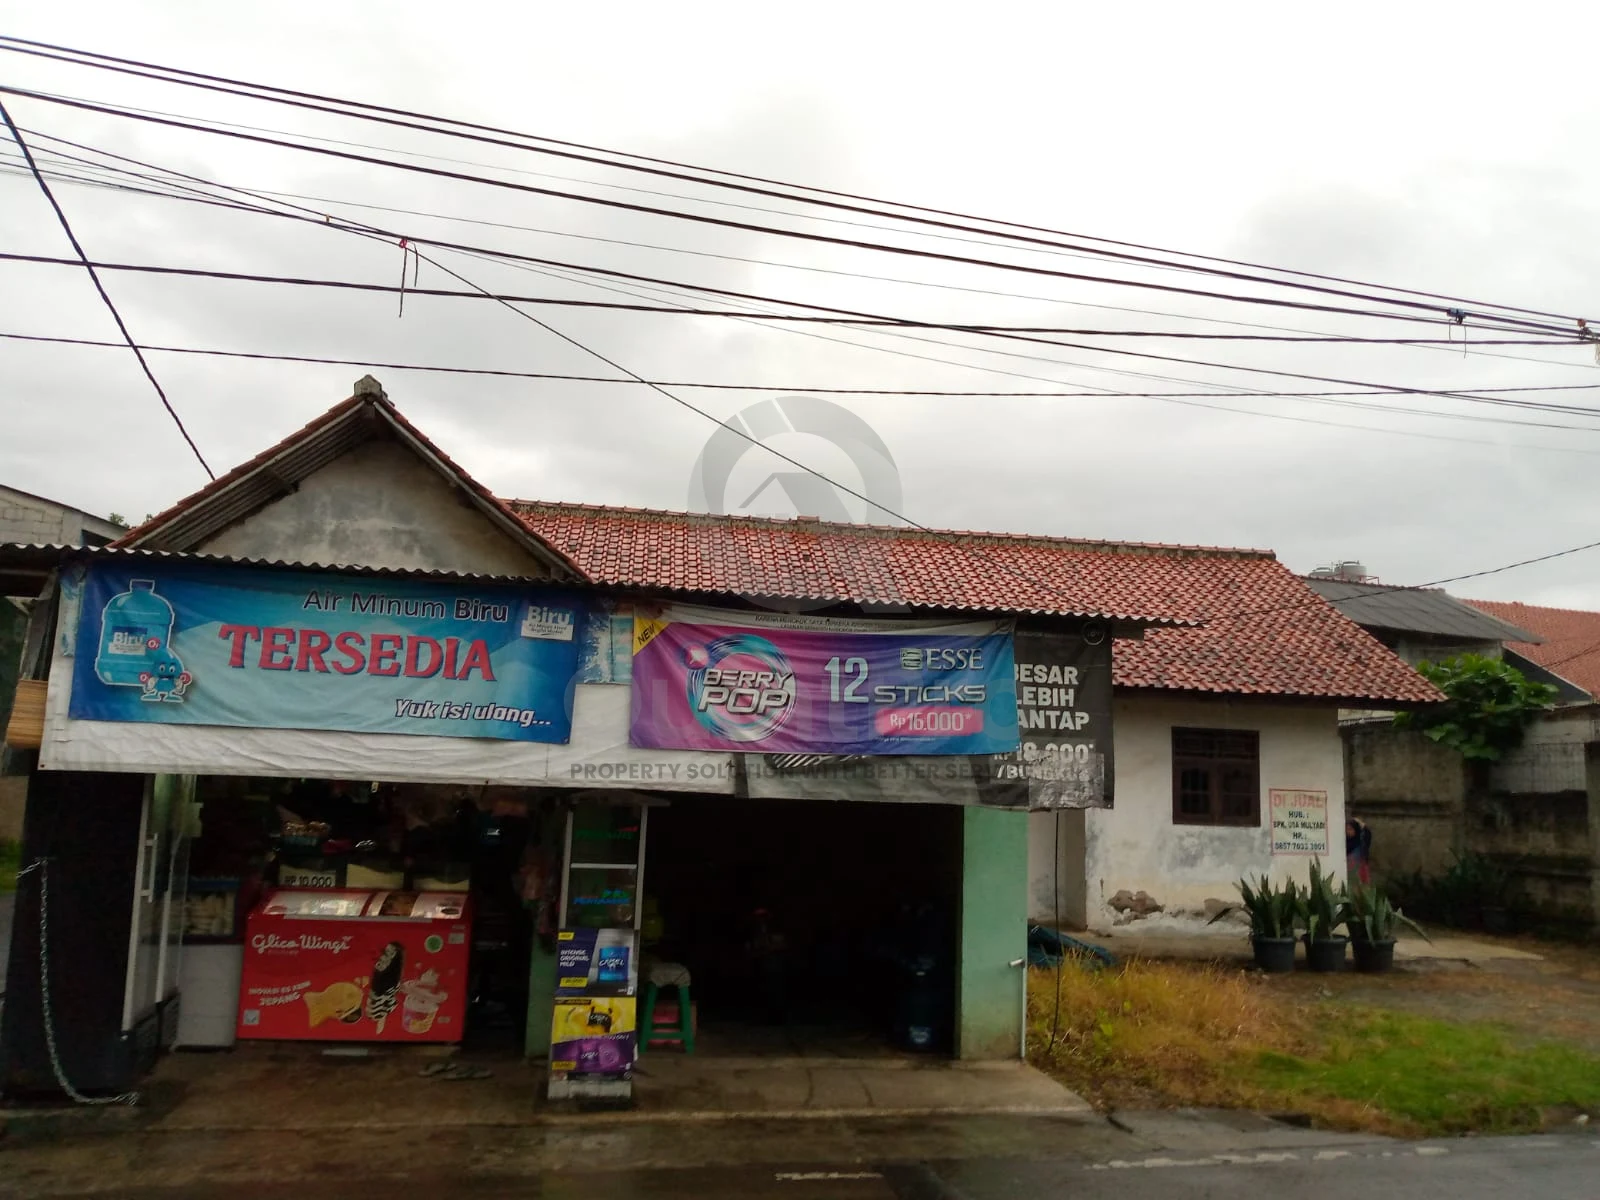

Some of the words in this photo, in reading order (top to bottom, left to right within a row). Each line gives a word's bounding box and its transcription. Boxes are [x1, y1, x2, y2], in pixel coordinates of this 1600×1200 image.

[303, 589, 343, 612] Air
[350, 592, 446, 619] Minum
[453, 598, 508, 623] Biru
[527, 606, 570, 624] Biru
[113, 632, 144, 644] Biru
[637, 624, 655, 645] NEW
[218, 624, 498, 682] TERSEDIA
[926, 648, 984, 670] ESSE
[704, 668, 792, 689] BERRY
[824, 656, 869, 703] 12
[1014, 663, 1079, 685] ESAR
[698, 687, 790, 715] POP
[873, 684, 986, 704] STICKS
[395, 699, 439, 719] Yuk
[440, 701, 472, 721] isi
[473, 703, 551, 727] ulang...
[1016, 709, 1090, 731] ANTAP
[252, 934, 298, 953] Glico
[300, 934, 352, 953] Wings
